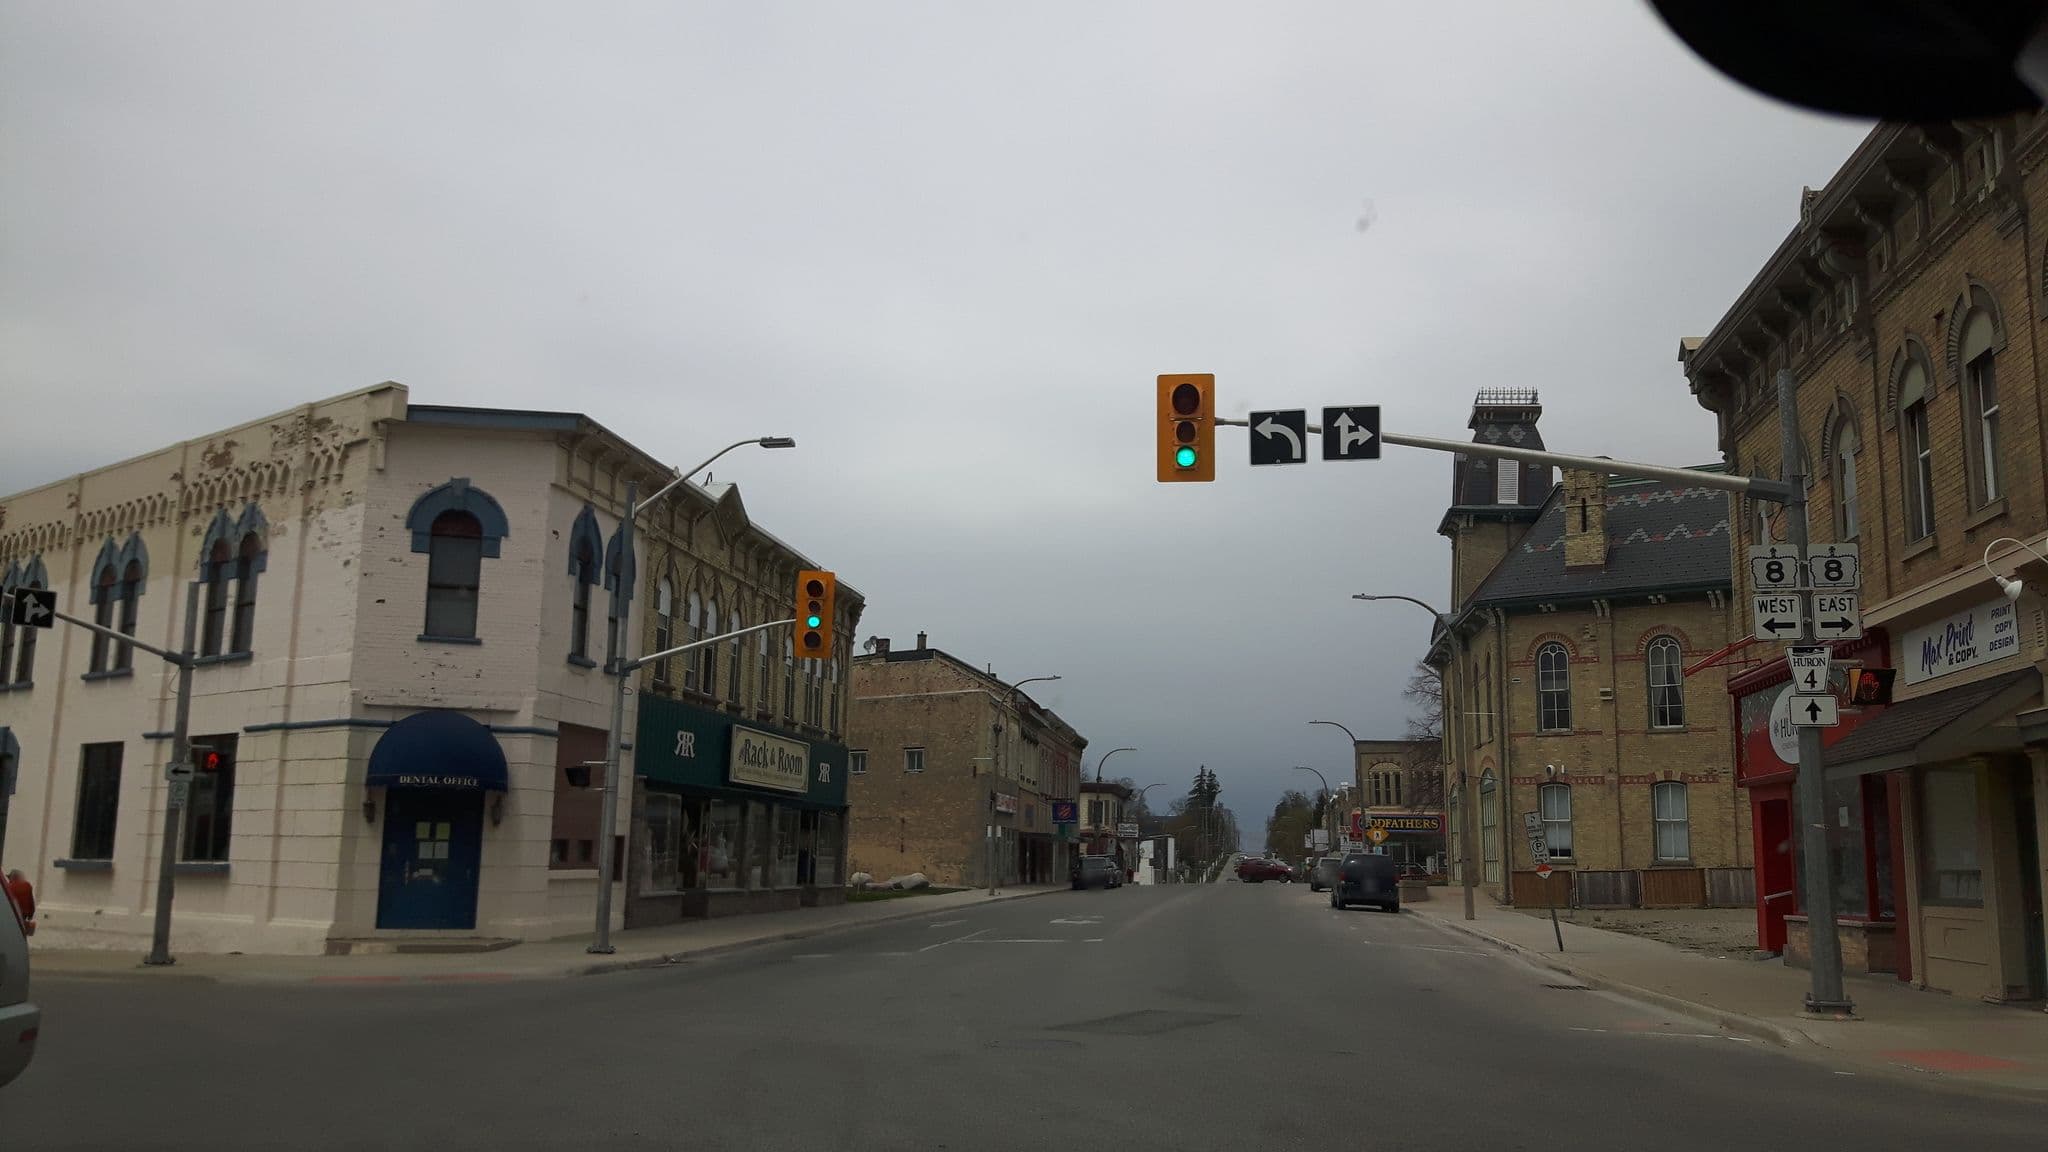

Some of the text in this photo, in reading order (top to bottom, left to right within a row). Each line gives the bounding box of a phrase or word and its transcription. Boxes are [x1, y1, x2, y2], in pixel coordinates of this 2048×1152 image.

[1765, 560, 1785, 583] 8
[1824, 559, 1844, 582] 8
[1757, 599, 1795, 613] WEST
[1818, 597, 1854, 612] EAST
[1991, 604, 2011, 619] PRINT
[1994, 619, 2013, 634] COPY
[1921, 613, 1975, 675] Max Print
[1989, 635, 2015, 652] DESIGN
[1793, 657, 1826, 667] HURON
[1948, 652, 1954, 665] &
[1803, 669, 1818, 689] 4
[743, 738, 769, 768] Rack
[777, 746, 803, 776] Room
[399, 775, 479, 786] DENTAL OFFICE
